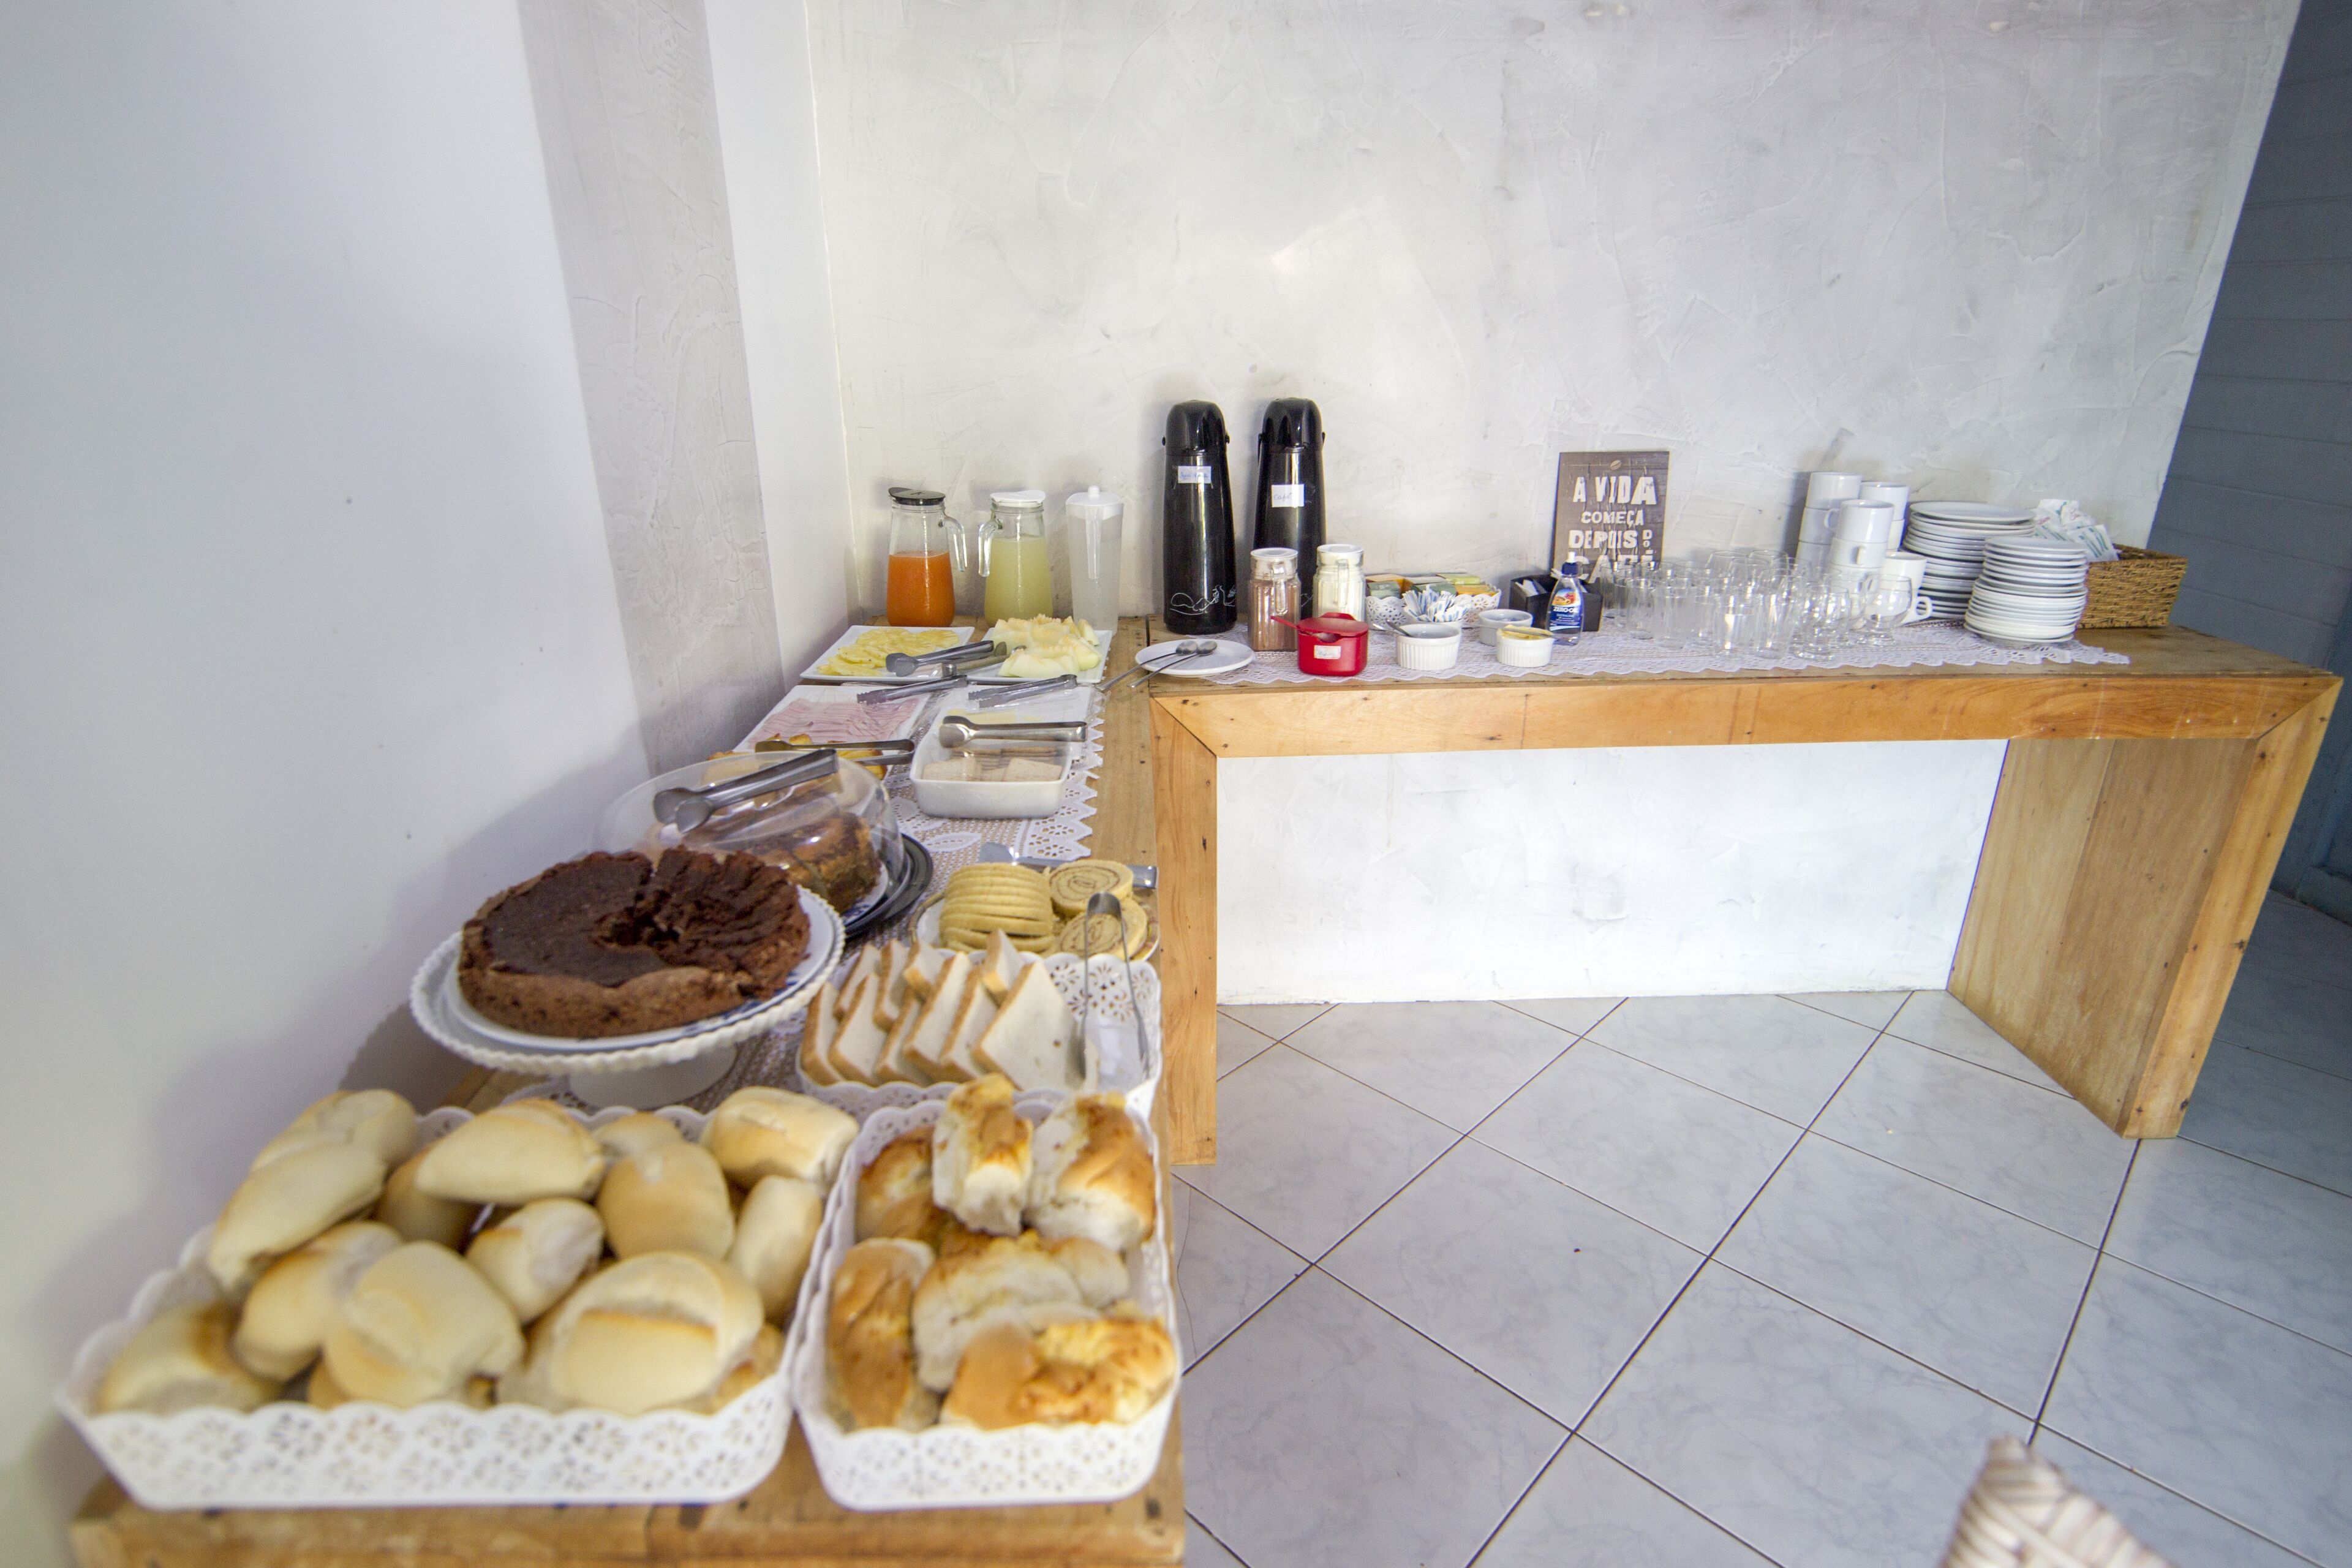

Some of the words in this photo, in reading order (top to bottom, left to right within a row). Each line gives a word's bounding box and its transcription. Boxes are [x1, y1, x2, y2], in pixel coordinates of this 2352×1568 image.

[1572, 477, 1587, 502] A
[1595, 475, 1657, 505] VIDA
[1581, 510, 1644, 529] COMEÇA
